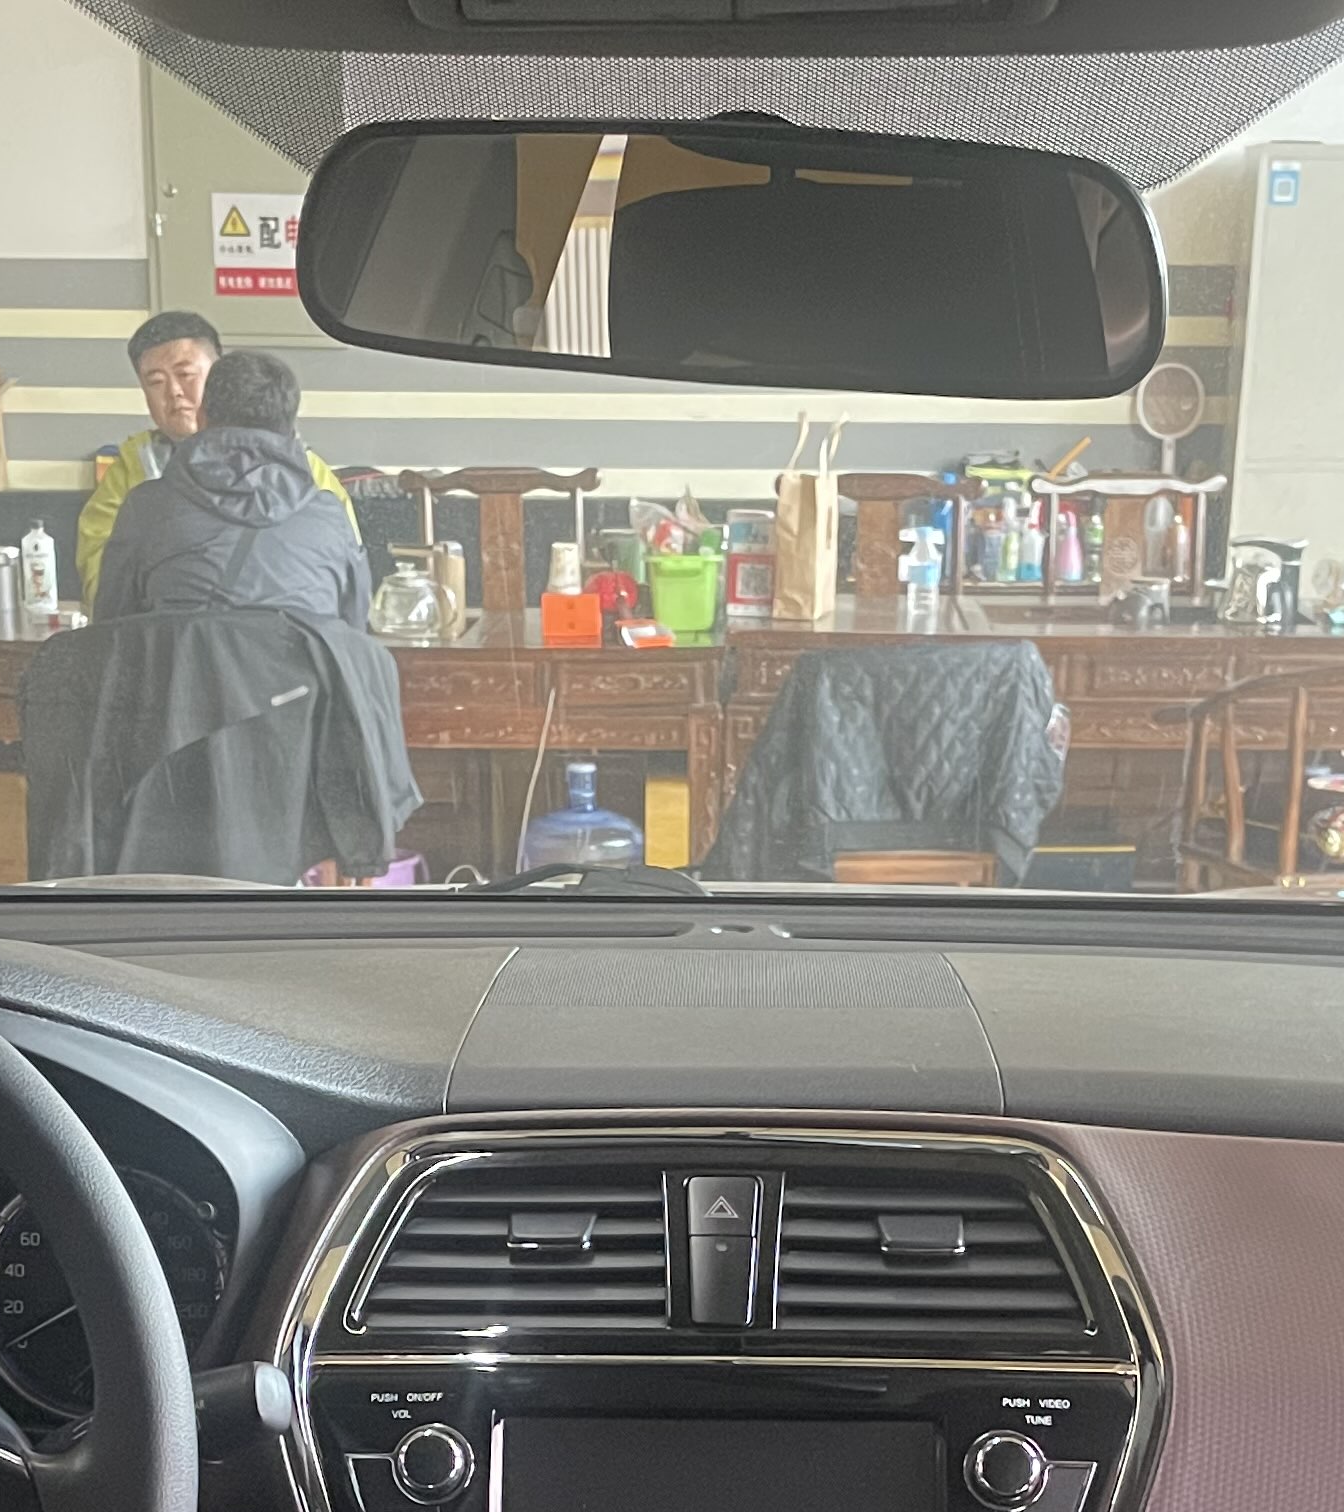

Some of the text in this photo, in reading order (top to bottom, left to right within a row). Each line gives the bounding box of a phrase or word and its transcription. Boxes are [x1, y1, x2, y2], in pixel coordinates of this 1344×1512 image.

[20, 1232, 41, 1247] 60
[4, 1263, 25, 1278] 40
[3, 1300, 24, 1315] 20
[370, 1392, 398, 1402] PUSH
[1001, 1397, 1071, 1409] PUSH VIDEO
[391, 1409, 412, 1419] VOL
[1024, 1414, 1053, 1426] TUNE
